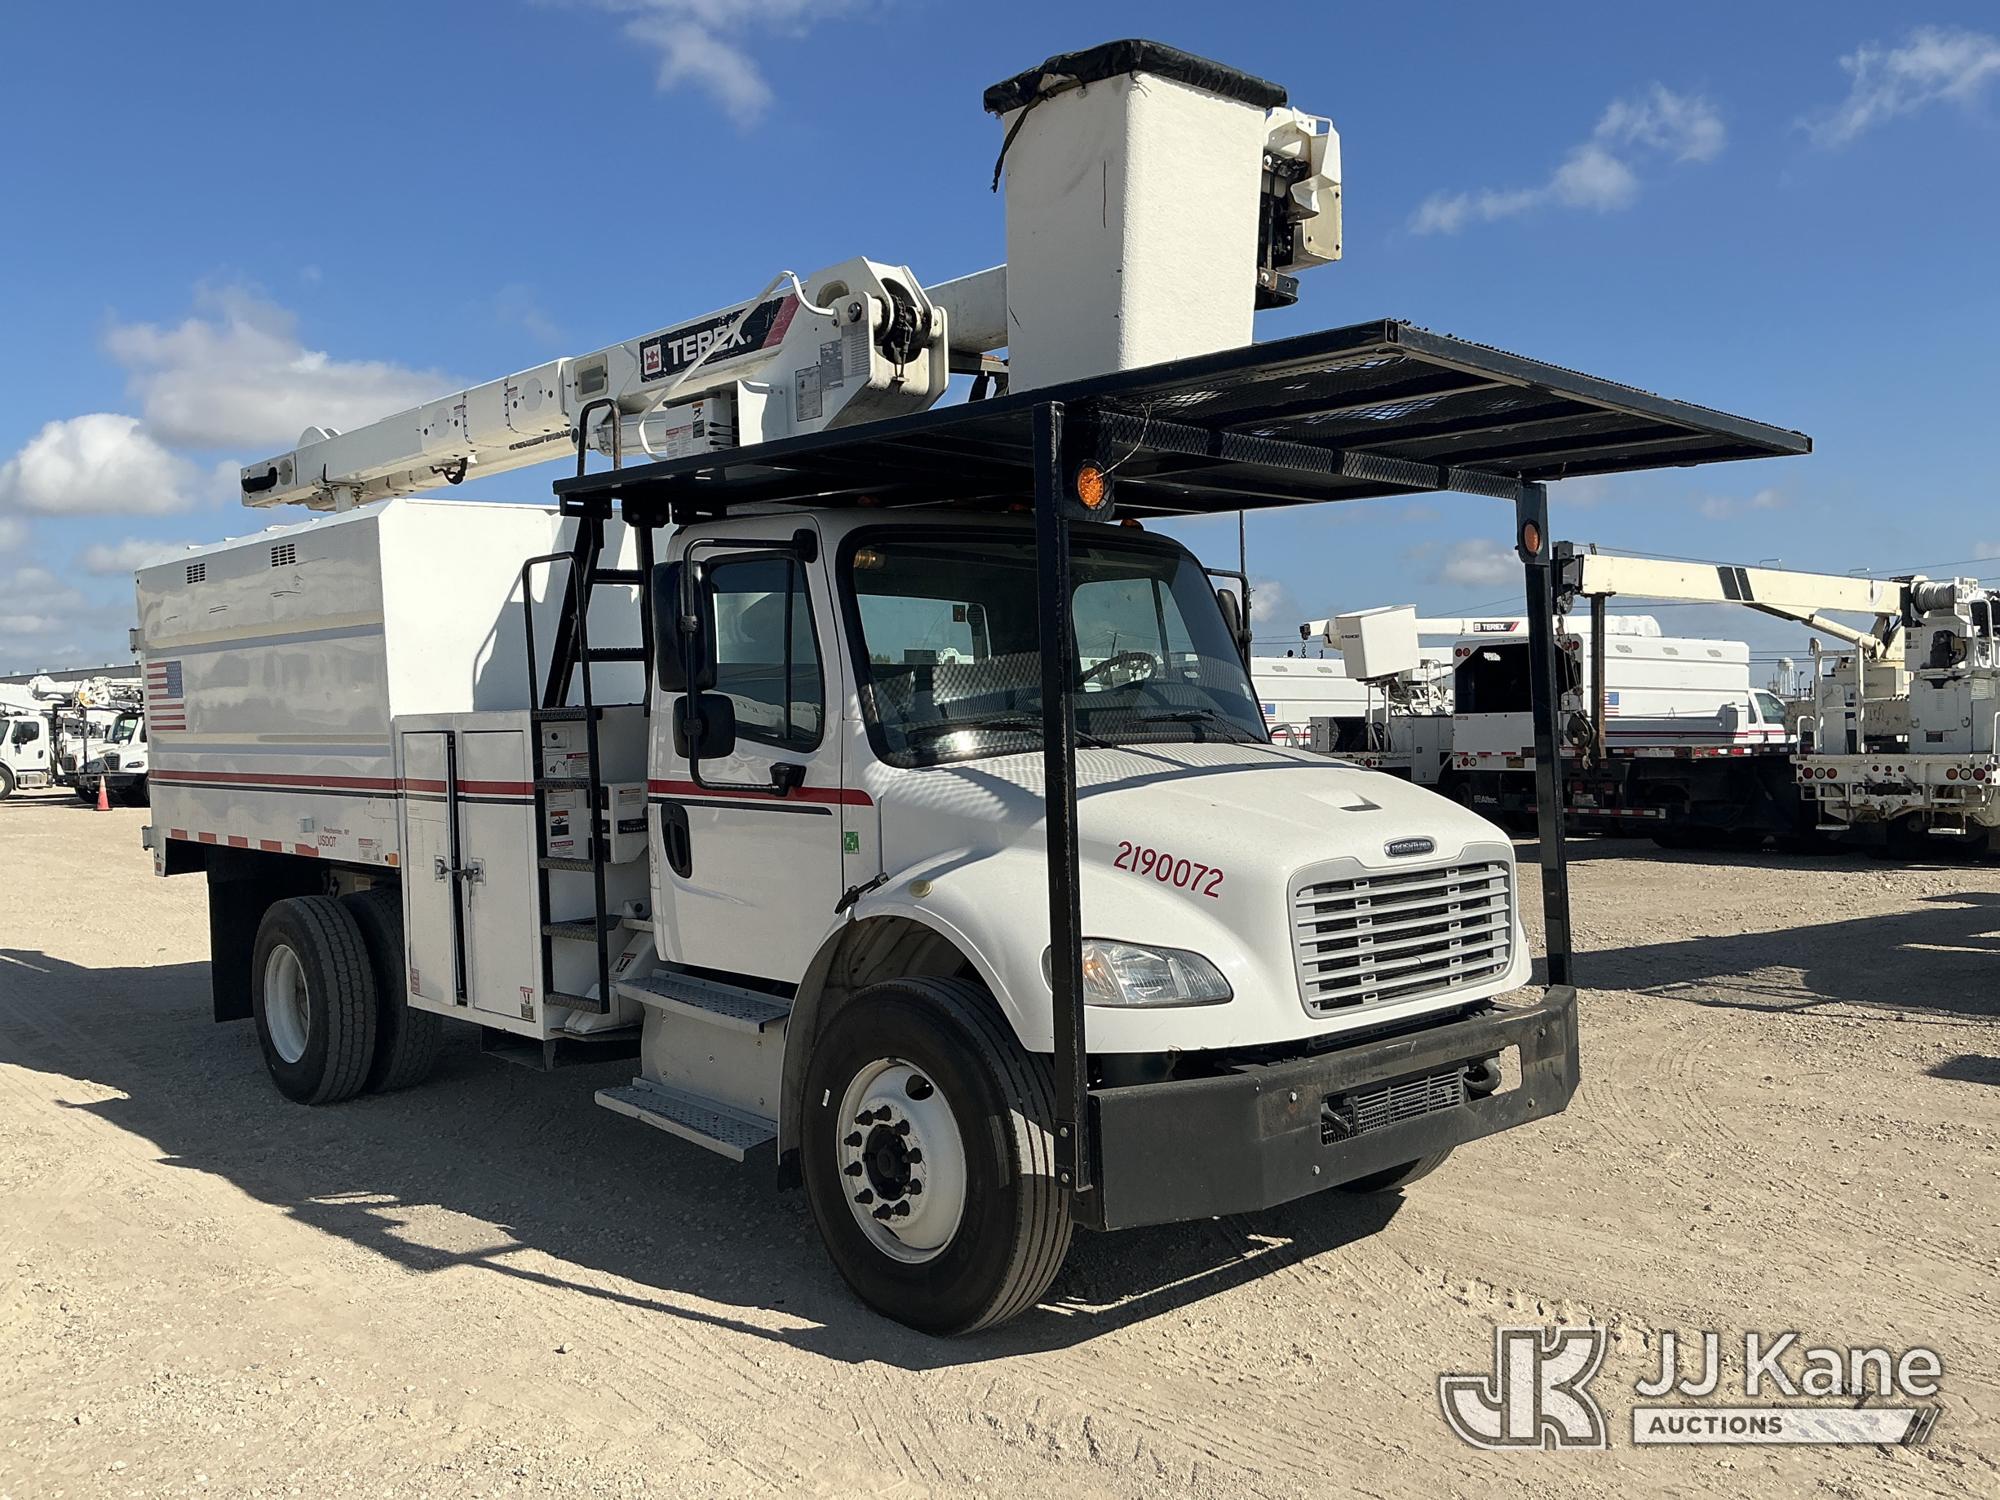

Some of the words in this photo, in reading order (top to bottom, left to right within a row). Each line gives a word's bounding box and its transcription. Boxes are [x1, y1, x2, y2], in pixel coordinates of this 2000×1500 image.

[667, 321, 746, 365] TEREX
[1482, 623, 1505, 631] TEREX
[317, 835, 337, 847] USDOT
[1113, 841, 1224, 898] 2190072
